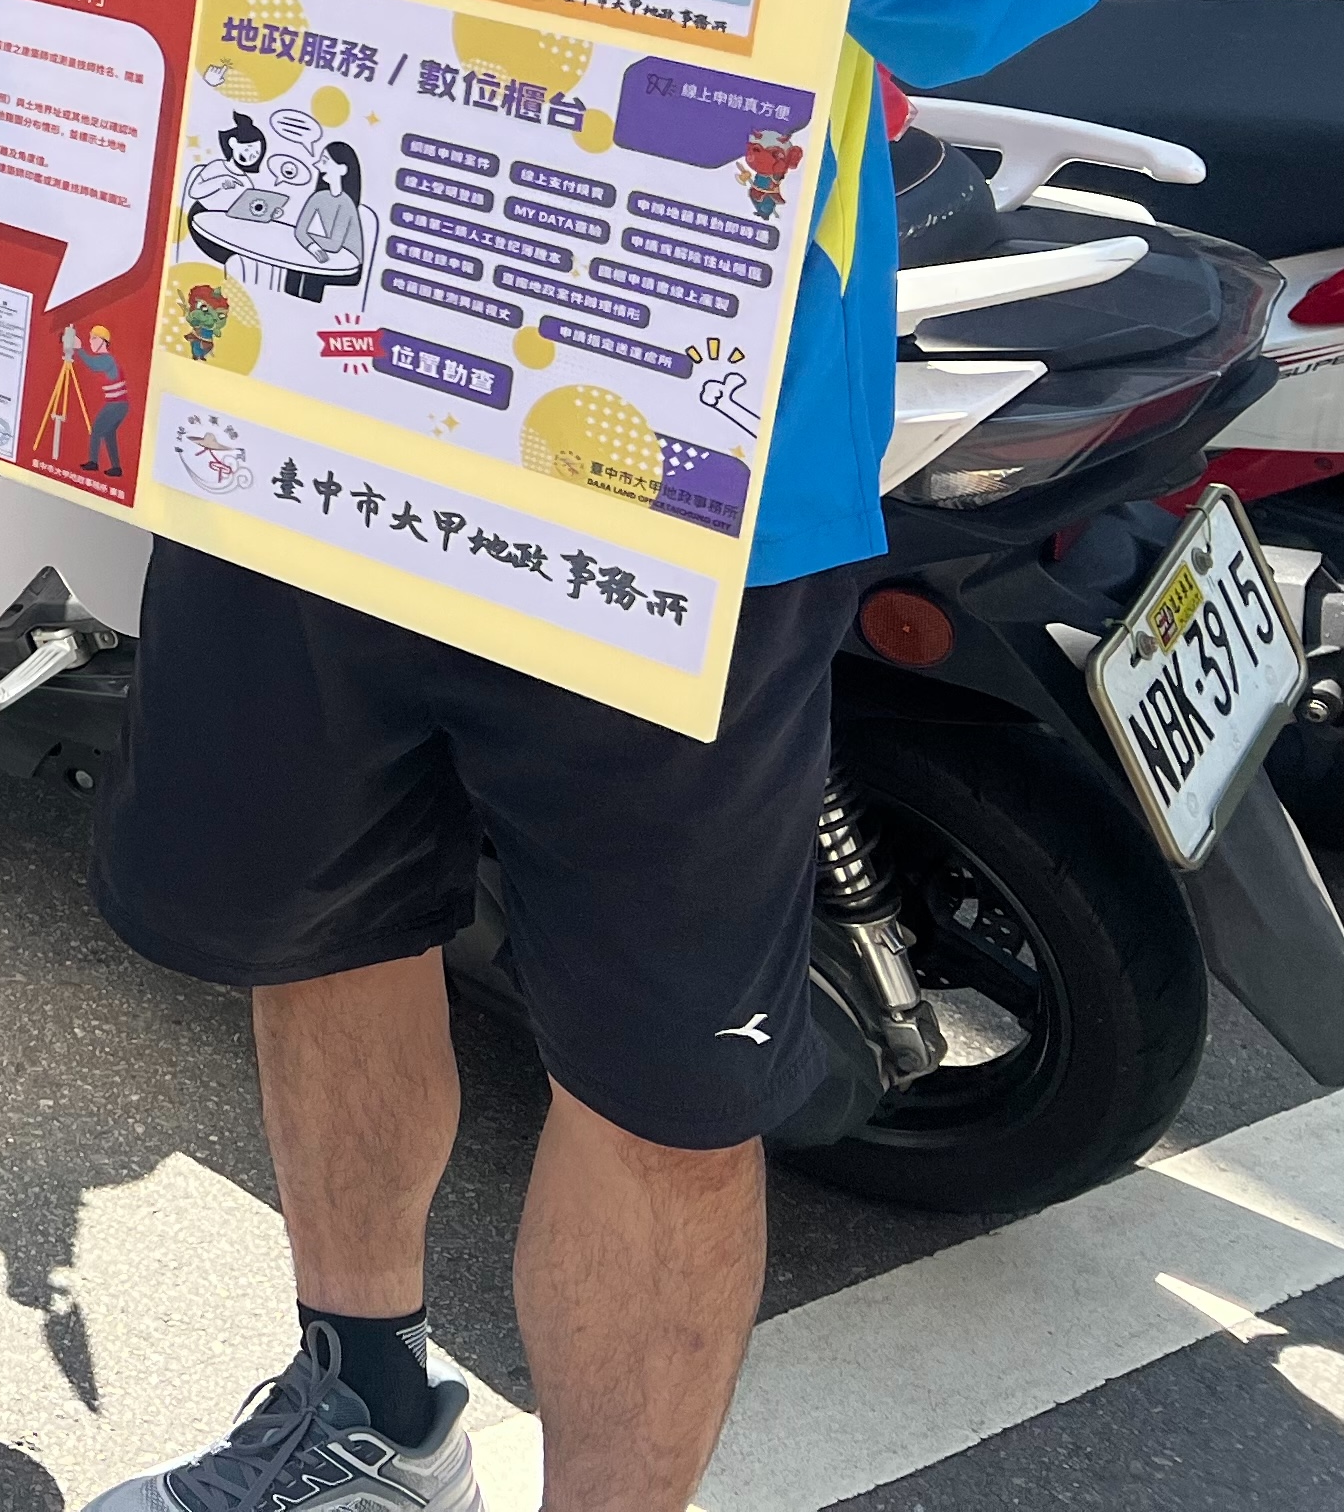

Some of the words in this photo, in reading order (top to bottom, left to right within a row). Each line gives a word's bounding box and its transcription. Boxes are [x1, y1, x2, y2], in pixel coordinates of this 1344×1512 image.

[219, 10, 381, 83] 地政服務
[415, 57, 590, 135] 數位櫃台
[680, 80, 793, 123] 線上申辦真方便
[327, 333, 376, 356] NEW!
[388, 339, 497, 397] 位置勘查
[588, 459, 739, 521] 臺中市大甲地政事務所
[271, 457, 689, 627] 臺中市大甲地政事務所
